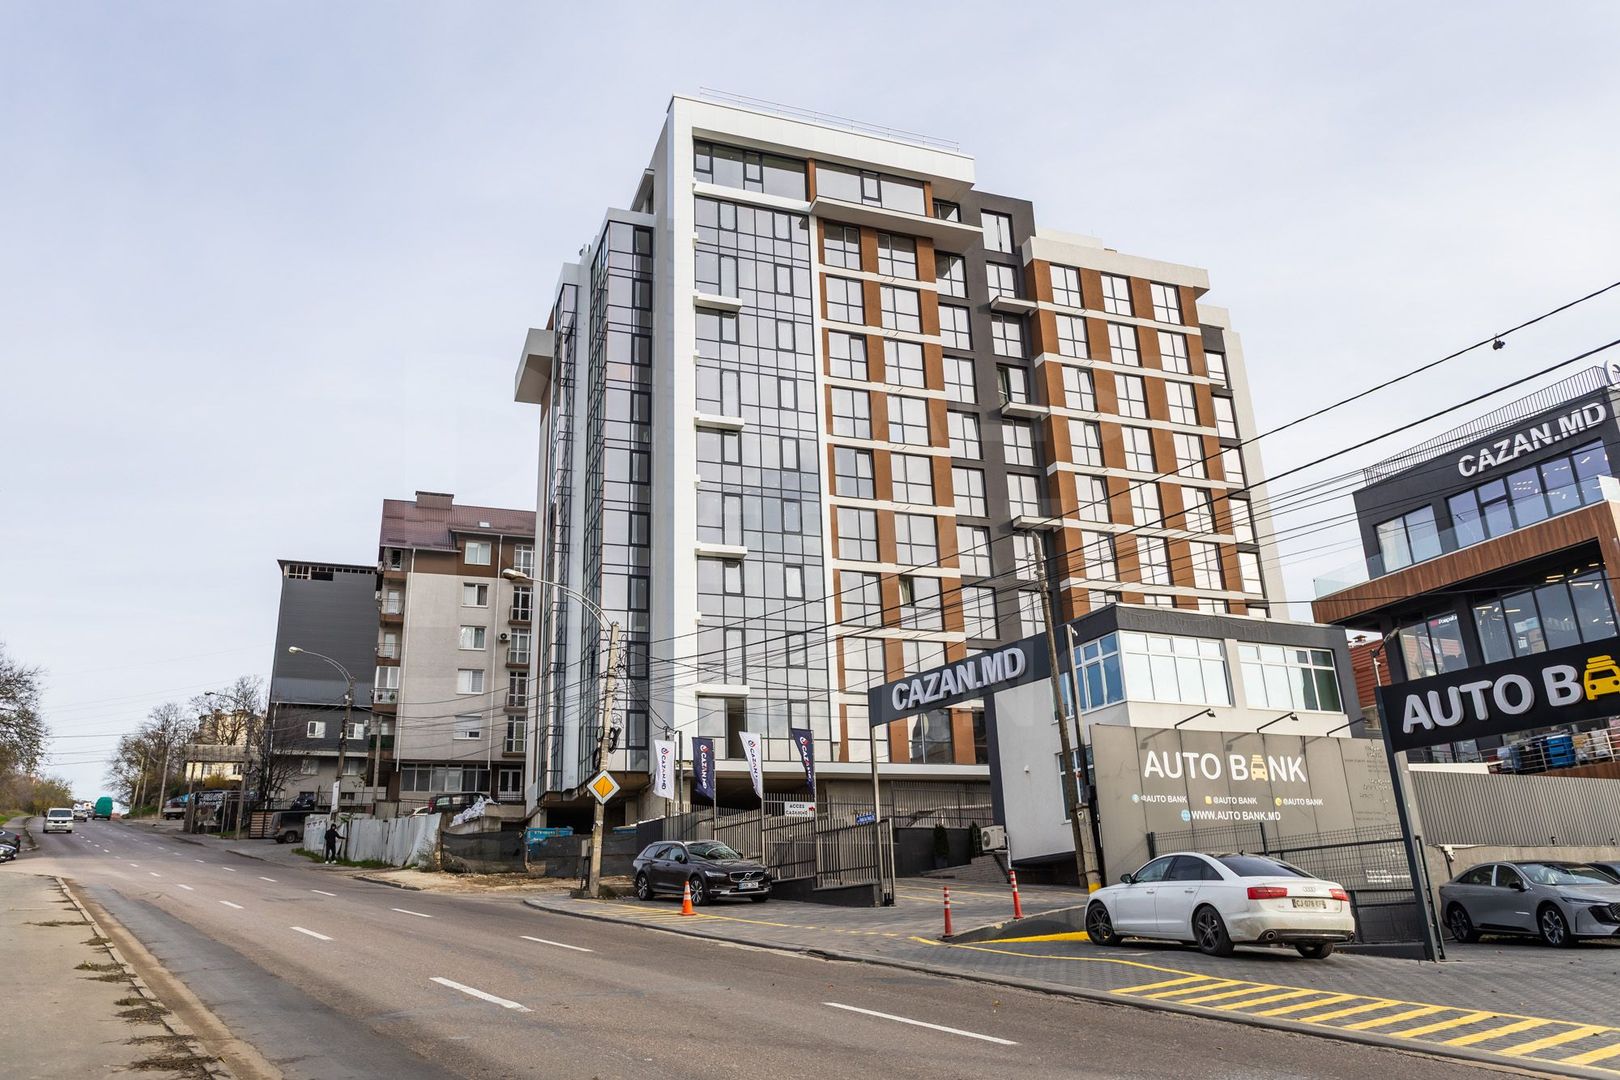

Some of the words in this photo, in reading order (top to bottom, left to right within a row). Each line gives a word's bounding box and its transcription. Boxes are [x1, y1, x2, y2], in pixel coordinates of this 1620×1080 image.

[1457, 401, 1608, 478] CAZAN.MD
[892, 647, 1027, 711] CAZAN.MD
[1402, 673, 1535, 734] AUTO
[1144, 750, 1222, 780] AUTO
[1167, 795, 1188, 804] BANK
[1213, 796, 1237, 805] @AUTO
[1238, 797, 1258, 805] BANK
[1283, 798, 1305, 806] @AUTO
[1305, 798, 1324, 806] BANK
[1191, 810, 1241, 821] WWW.AUTO
[1242, 811, 1281, 821] BANK.MD
